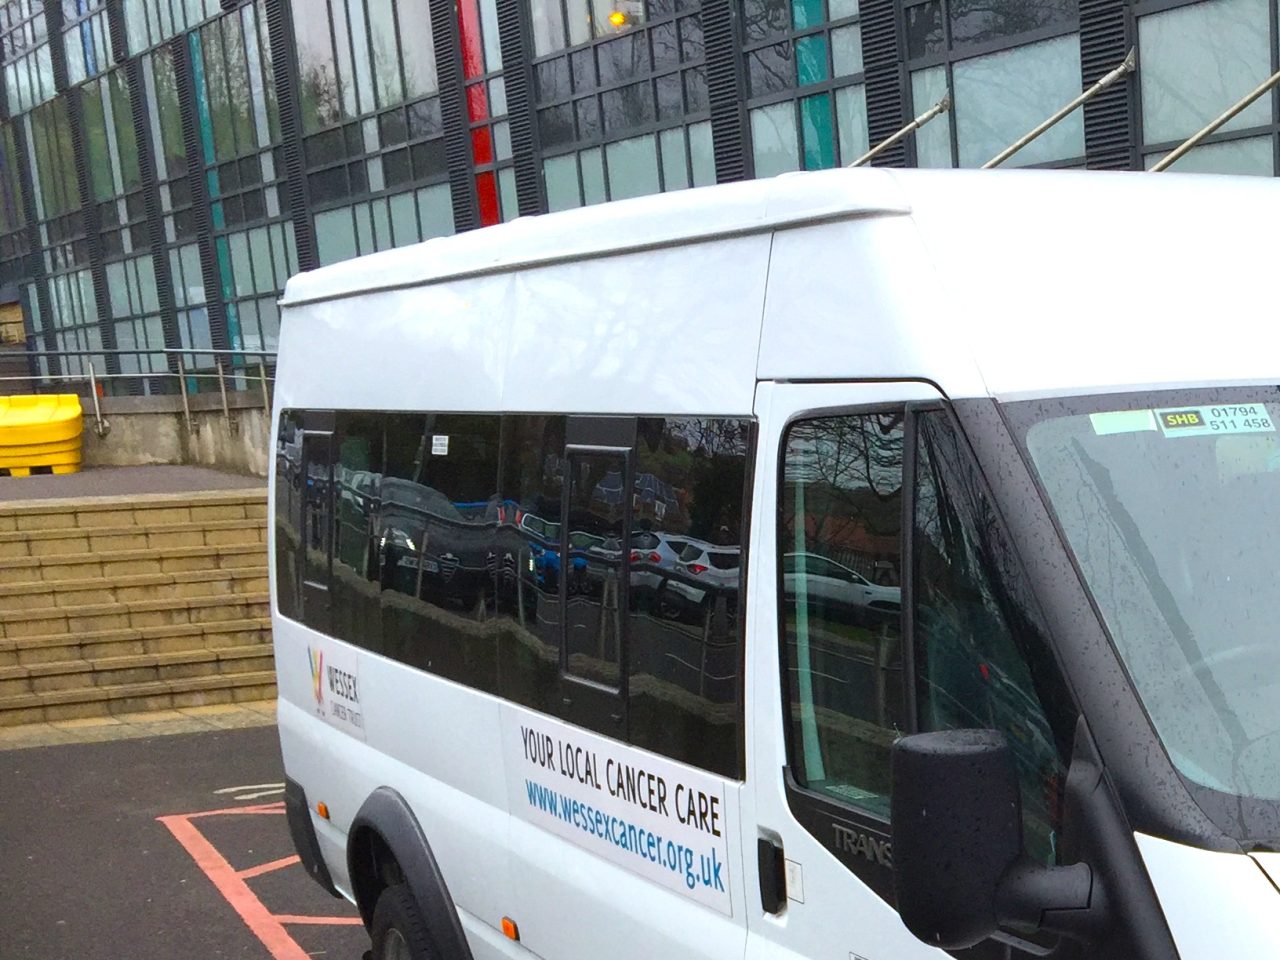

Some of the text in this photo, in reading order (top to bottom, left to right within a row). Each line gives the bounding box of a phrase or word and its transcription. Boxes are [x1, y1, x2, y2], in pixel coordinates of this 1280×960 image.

[1166, 406, 1258, 426] SHB 01794
[1209, 418, 1271, 431] 511 458
[326, 665, 359, 703] WESSEX
[521, 725, 721, 838] YOUR LOCAL CANCER CARE
[525, 778, 725, 893] www.wessexcancer.org.uk
